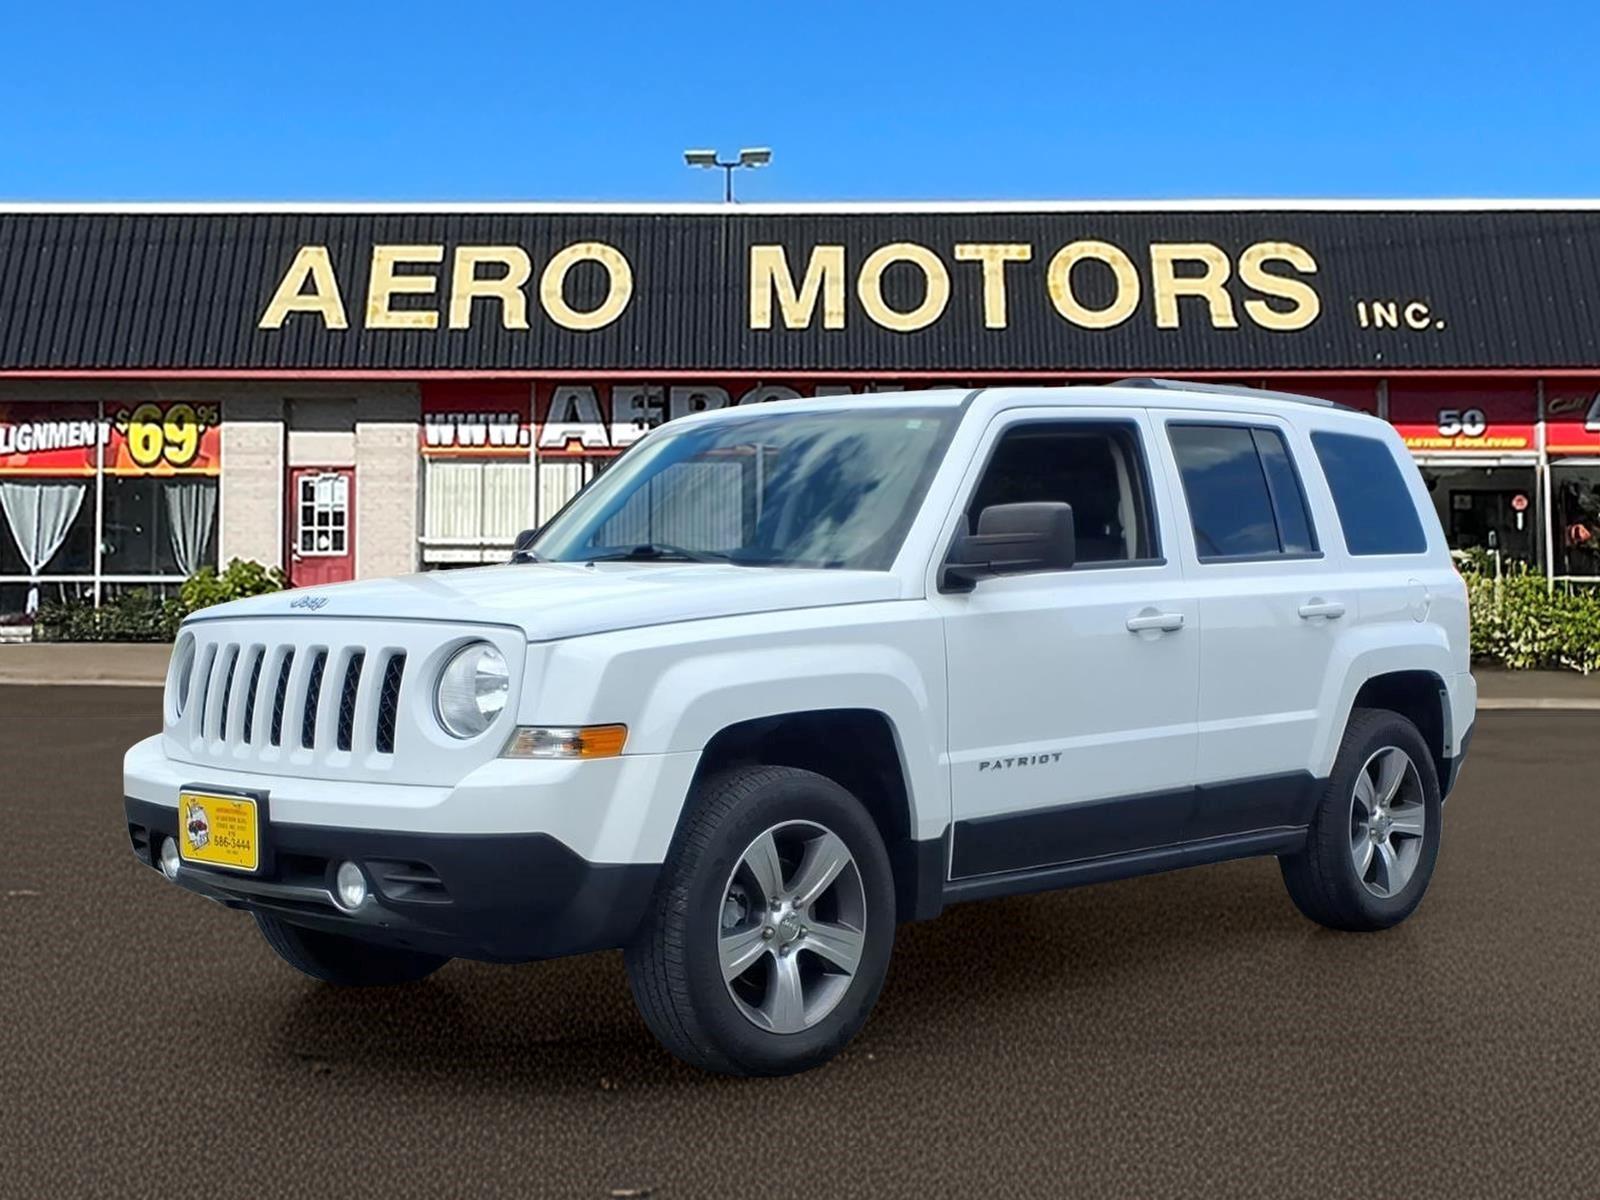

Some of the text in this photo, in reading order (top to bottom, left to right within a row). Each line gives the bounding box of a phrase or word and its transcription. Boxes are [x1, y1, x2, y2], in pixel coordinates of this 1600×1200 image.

[257, 240, 1445, 331] AERO MOTORS INC.
[1438, 408, 1486, 437] 50
[1403, 437, 1452, 448] ASTERN
[978, 752, 1063, 772] PATRIOT
[213, 835, 251, 851] 586-3444
